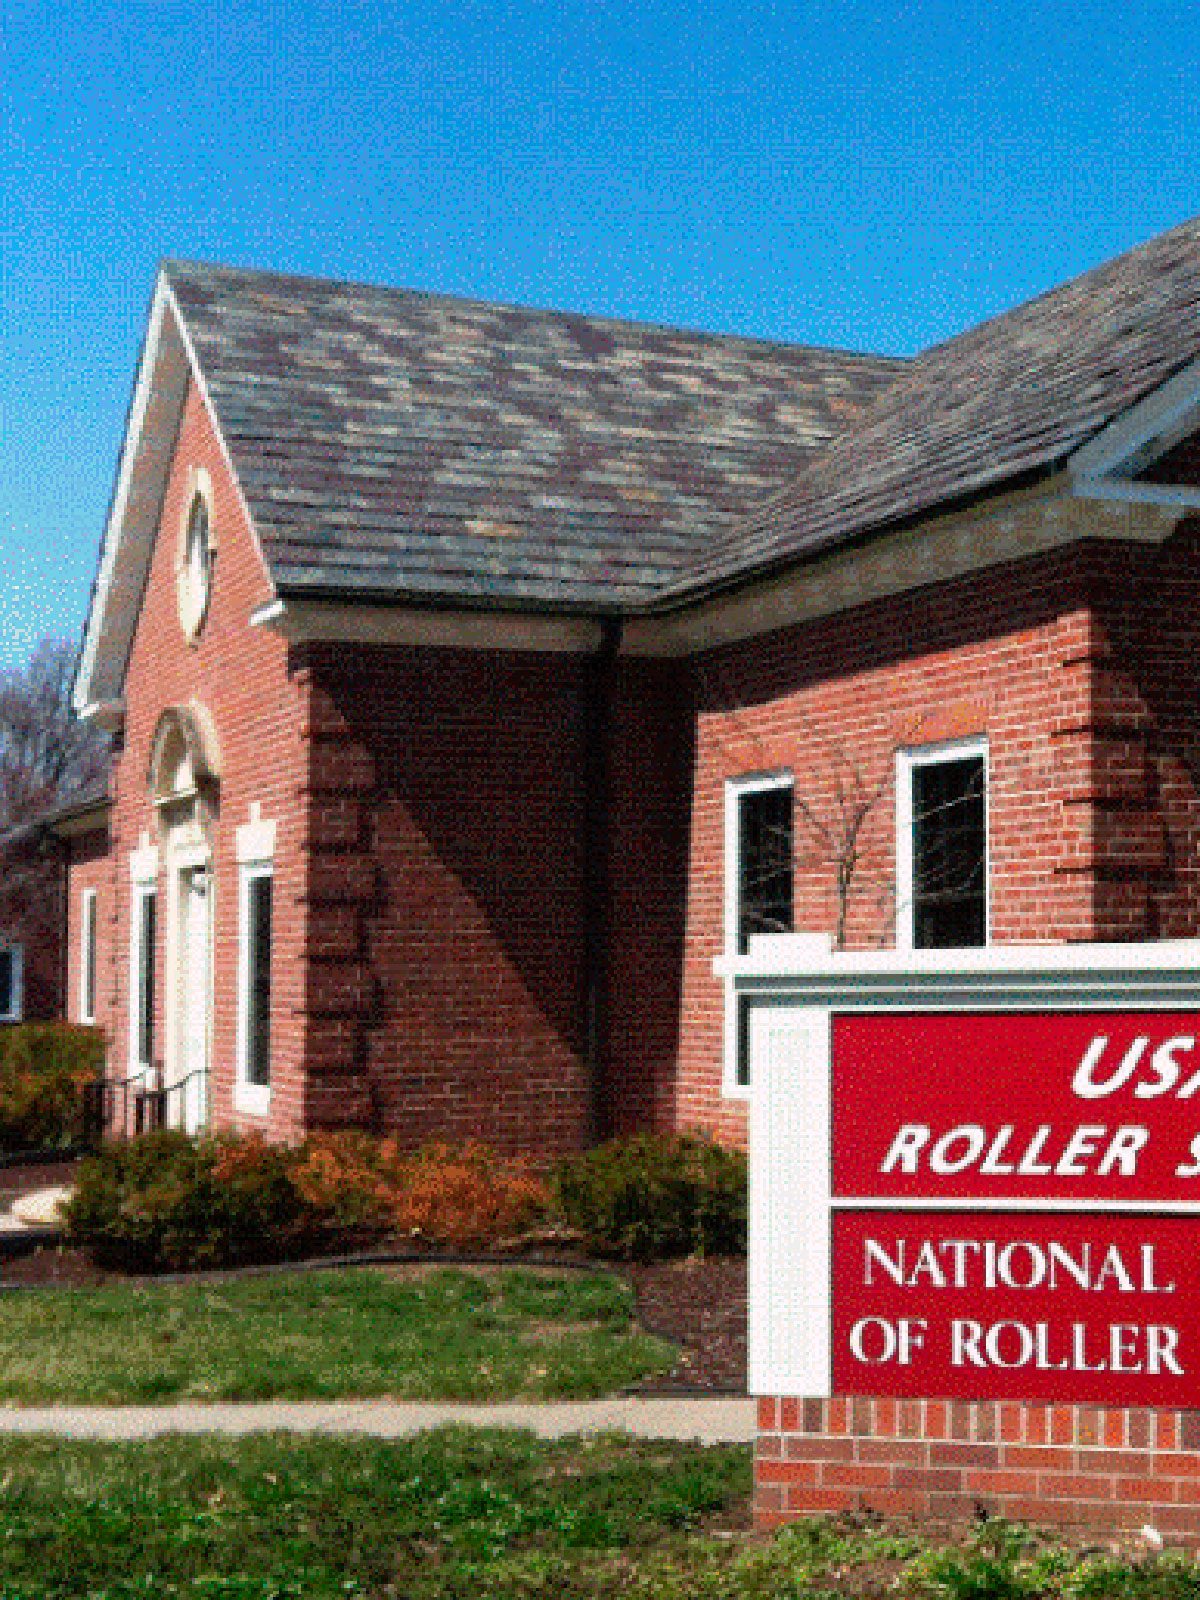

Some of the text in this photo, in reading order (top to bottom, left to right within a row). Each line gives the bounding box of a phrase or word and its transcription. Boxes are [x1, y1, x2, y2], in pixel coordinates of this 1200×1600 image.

[881, 1124, 1149, 1175] ROLLER
[864, 1239, 1175, 1293] NATIONAL
[849, 1316, 928, 1365] OF
[952, 1320, 1184, 1375] ROLLER
